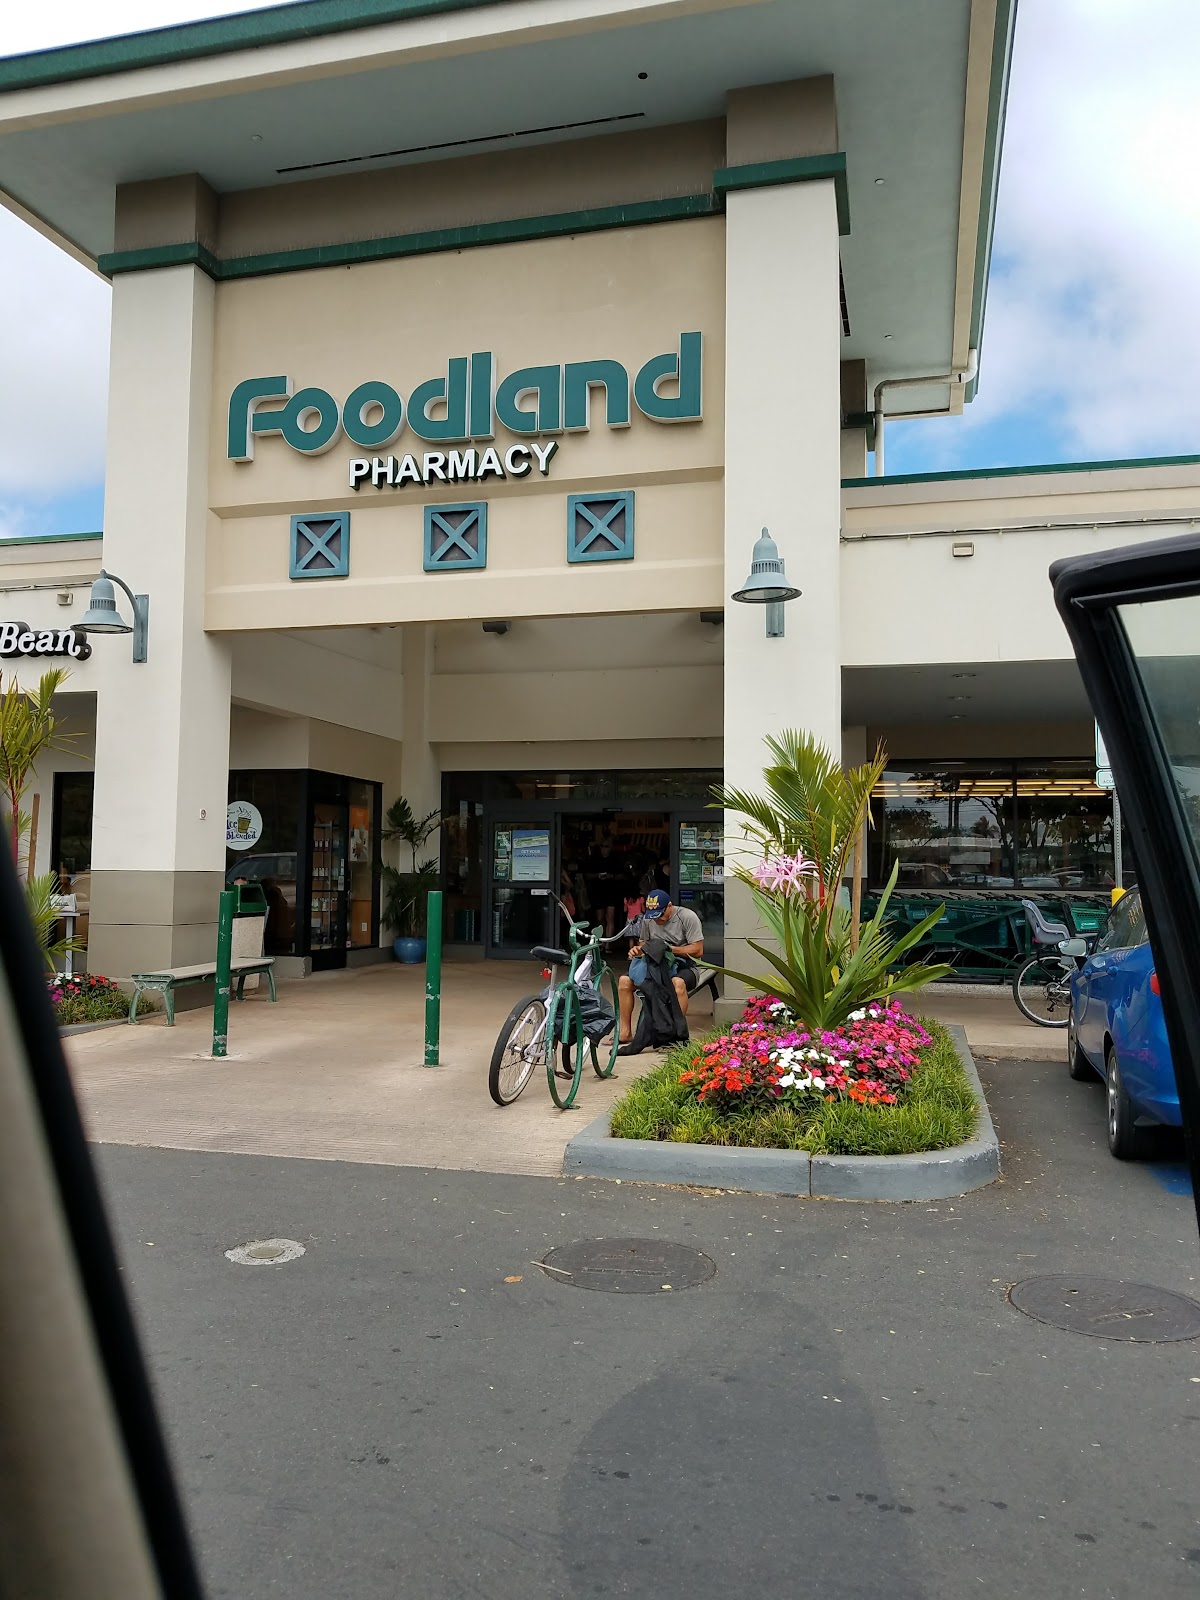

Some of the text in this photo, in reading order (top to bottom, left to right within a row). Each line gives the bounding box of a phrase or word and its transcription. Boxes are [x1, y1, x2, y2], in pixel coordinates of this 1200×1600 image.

[227, 331, 703, 463] Foodland
[348, 441, 559, 490] PHARMACY
[0, 622, 85, 660] Bean
